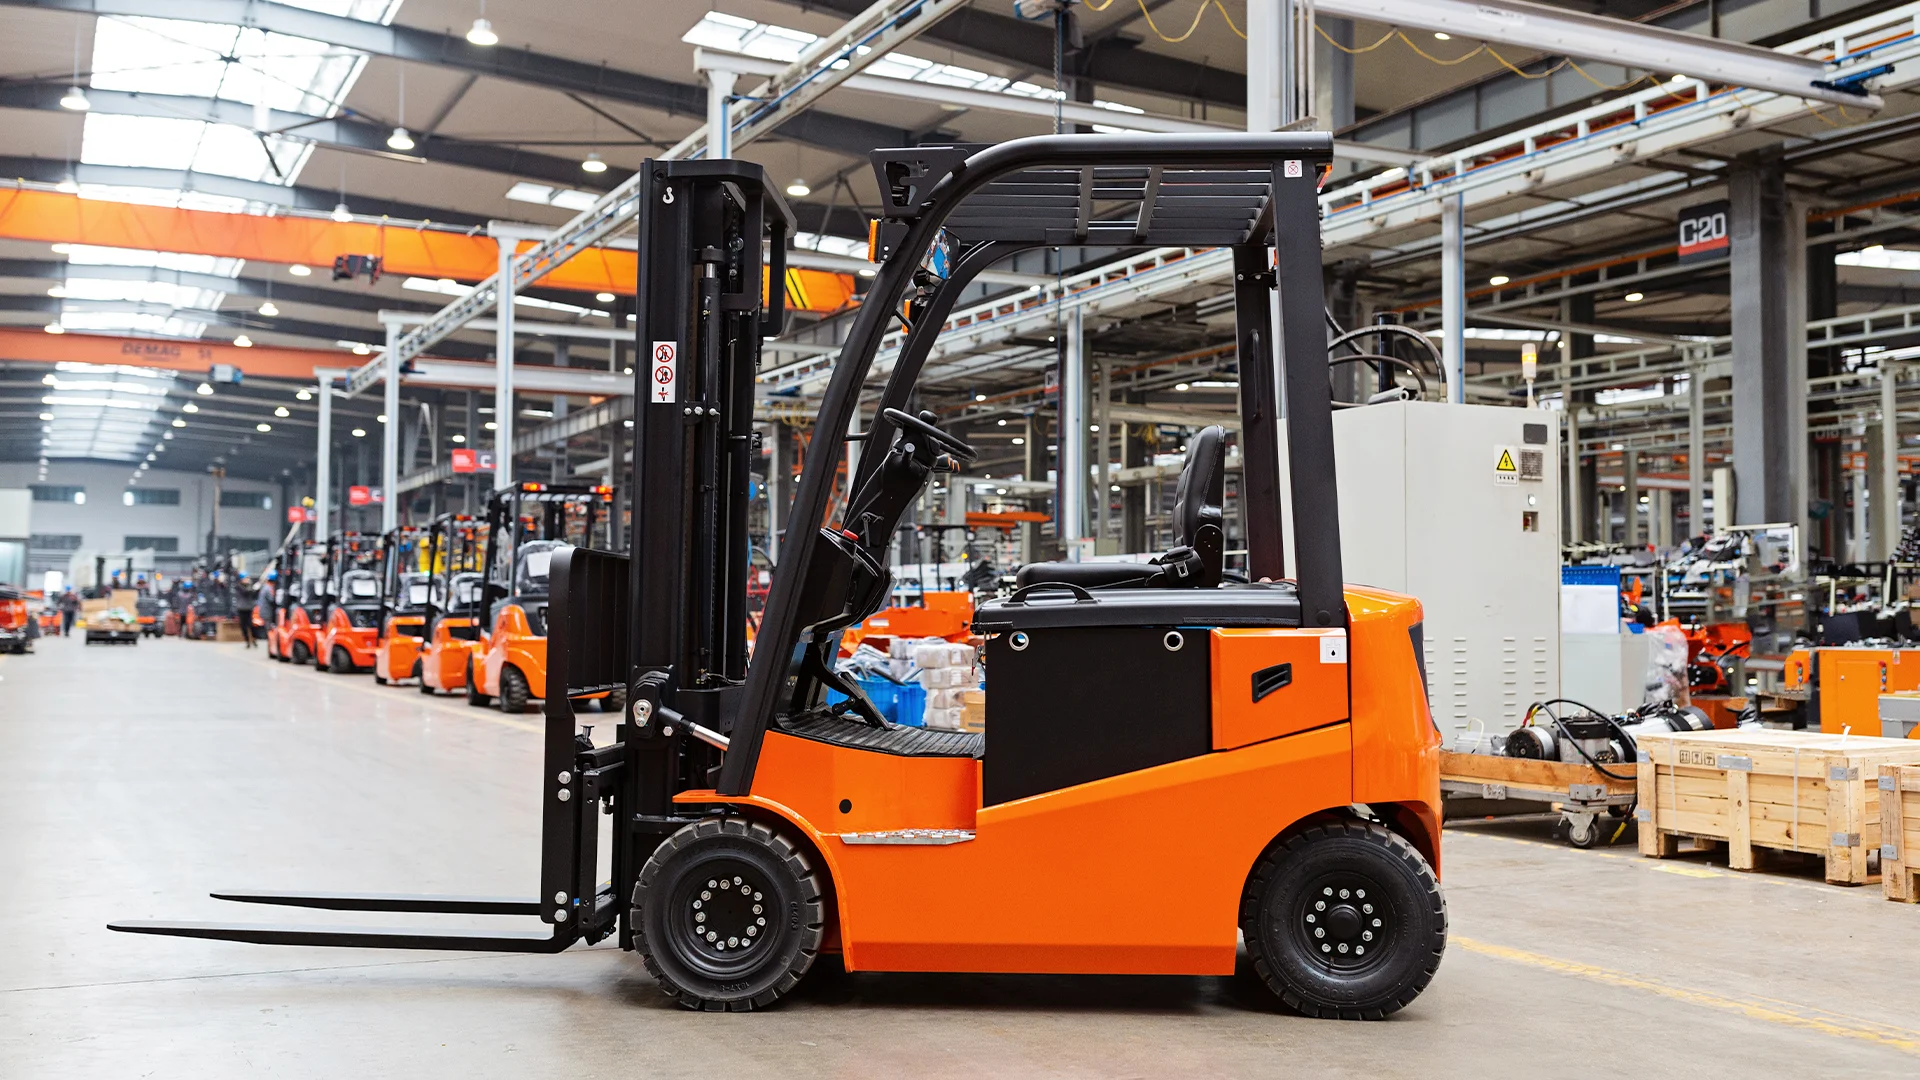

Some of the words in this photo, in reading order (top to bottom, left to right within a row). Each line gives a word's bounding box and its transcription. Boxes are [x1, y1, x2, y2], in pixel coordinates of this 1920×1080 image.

[1680, 212, 1726, 247] C20
[122, 343, 180, 356] DEMAG
[480, 455, 491, 468] C
